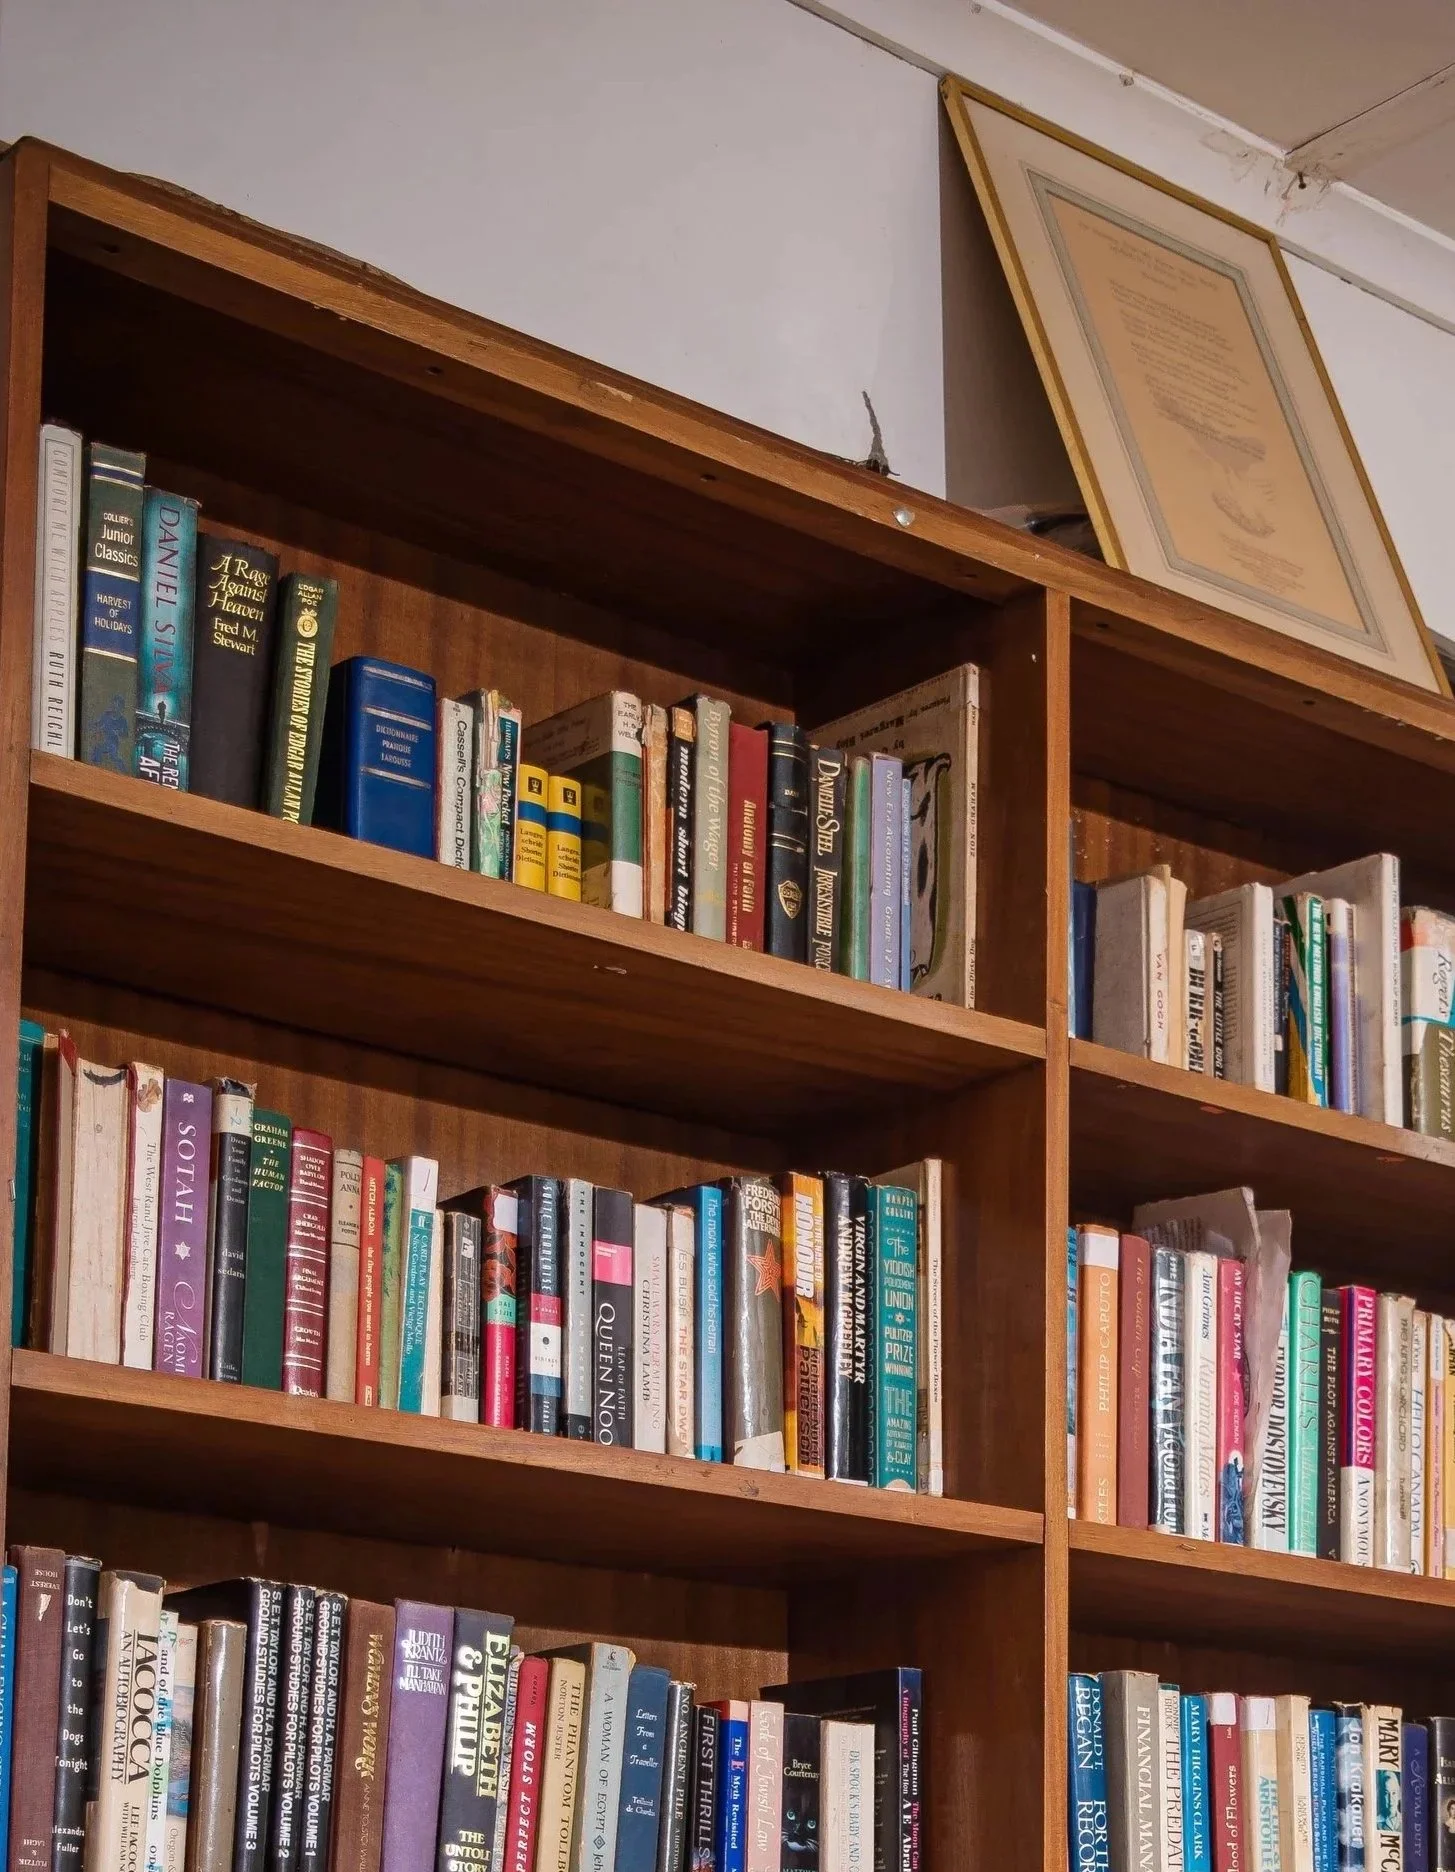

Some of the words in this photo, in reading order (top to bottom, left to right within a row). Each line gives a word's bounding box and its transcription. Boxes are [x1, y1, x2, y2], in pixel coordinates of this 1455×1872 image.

[101, 524, 135, 546] Junior
[95, 543, 138, 567] Classics
[156, 505, 180, 609] DANIEL
[211, 555, 231, 573] A
[235, 558, 270, 583] Rage
[96, 593, 132, 611] HARVEST
[209, 574, 268, 603] Against
[109, 608, 119, 618] OF
[208, 591, 264, 622] Heaven
[94, 616, 132, 635] HOLIDAYS
[213, 617, 240, 637] Fred
[242, 628, 258, 642] M.
[153, 620, 176, 695] SILVA
[213, 632, 255, 656] Stewart
[295, 642, 316, 666] THE
[48, 651, 65, 688] RUTH
[291, 666, 313, 712] STORIES
[46, 697, 63, 748] REICHL
[290, 714, 309, 732] OF
[287, 731, 307, 768] EDGAR
[284, 771, 304, 806] ALLAN
[1156, 953, 1164, 980] VAN
[1156, 990, 1164, 1030] GOGH
[1439, 1029, 1454, 1132] Thesaurus
[254, 1121, 289, 1139] GRAHAM
[254, 1133, 288, 1149] GREENE
[146, 1143, 156, 1163] The
[145, 1165, 155, 1191] West
[175, 1122, 196, 1224] SOTAH
[252, 1179, 285, 1193] FACTOR
[254, 1167, 286, 1182] HUMAN
[143, 1195, 154, 1222] Rand
[142, 1224, 153, 1247] Jive
[796, 1194, 814, 1298] HONOUR
[142, 1248, 152, 1272] Cats
[221, 1248, 245, 1262] david
[217, 1266, 246, 1280] sedaris
[138, 1273, 150, 1311] Boxing
[884, 1289, 915, 1311] UNION
[138, 1315, 149, 1341] Club
[163, 1310, 175, 1364] RAGEN
[1358, 1294, 1374, 1384] PRIMARY
[1326, 1347, 1336, 1372] THE
[1326, 1376, 1336, 1407] PLOT
[1326, 1411, 1337, 1464] AGAINST
[1356, 1386, 1373, 1464] COLORS
[1326, 1467, 1337, 1525] AMERICA
[67, 1593, 93, 1609] Don't
[67, 1621, 91, 1635] Let's
[257, 1588, 270, 1647] GROUND
[455, 1646, 482, 1670] &
[254, 1649, 269, 1703] STUDIES
[128, 1631, 158, 1784] IACOCCA
[570, 1682, 582, 1716] THE
[111, 1653, 132, 1784] AUTOBIOGRAPHY
[252, 1706, 265, 1733] FOR
[453, 1670, 484, 1777] PHILIP
[478, 1631, 511, 1800] ELIZABETH
[1077, 1686, 1093, 1769] REGAN
[62, 1729, 85, 1745] Dogs
[701, 1715, 714, 1769] FIRST
[1377, 1716, 1400, 1767] MARY
[249, 1735, 263, 1782] PILOTS
[523, 1721, 536, 1786] STORM
[561, 1724, 577, 1808] PHANTOM
[1136, 1706, 1153, 1813] FINANCIAL
[1225, 1765, 1237, 1820] Flowers
[246, 1785, 259, 1835] VOLUME
[698, 1778, 713, 1859] THRILLS
[1094, 1799, 1108, 1843] FOR
[245, 1838, 256, 1851] 3
[1226, 1822, 1237, 1842] of
